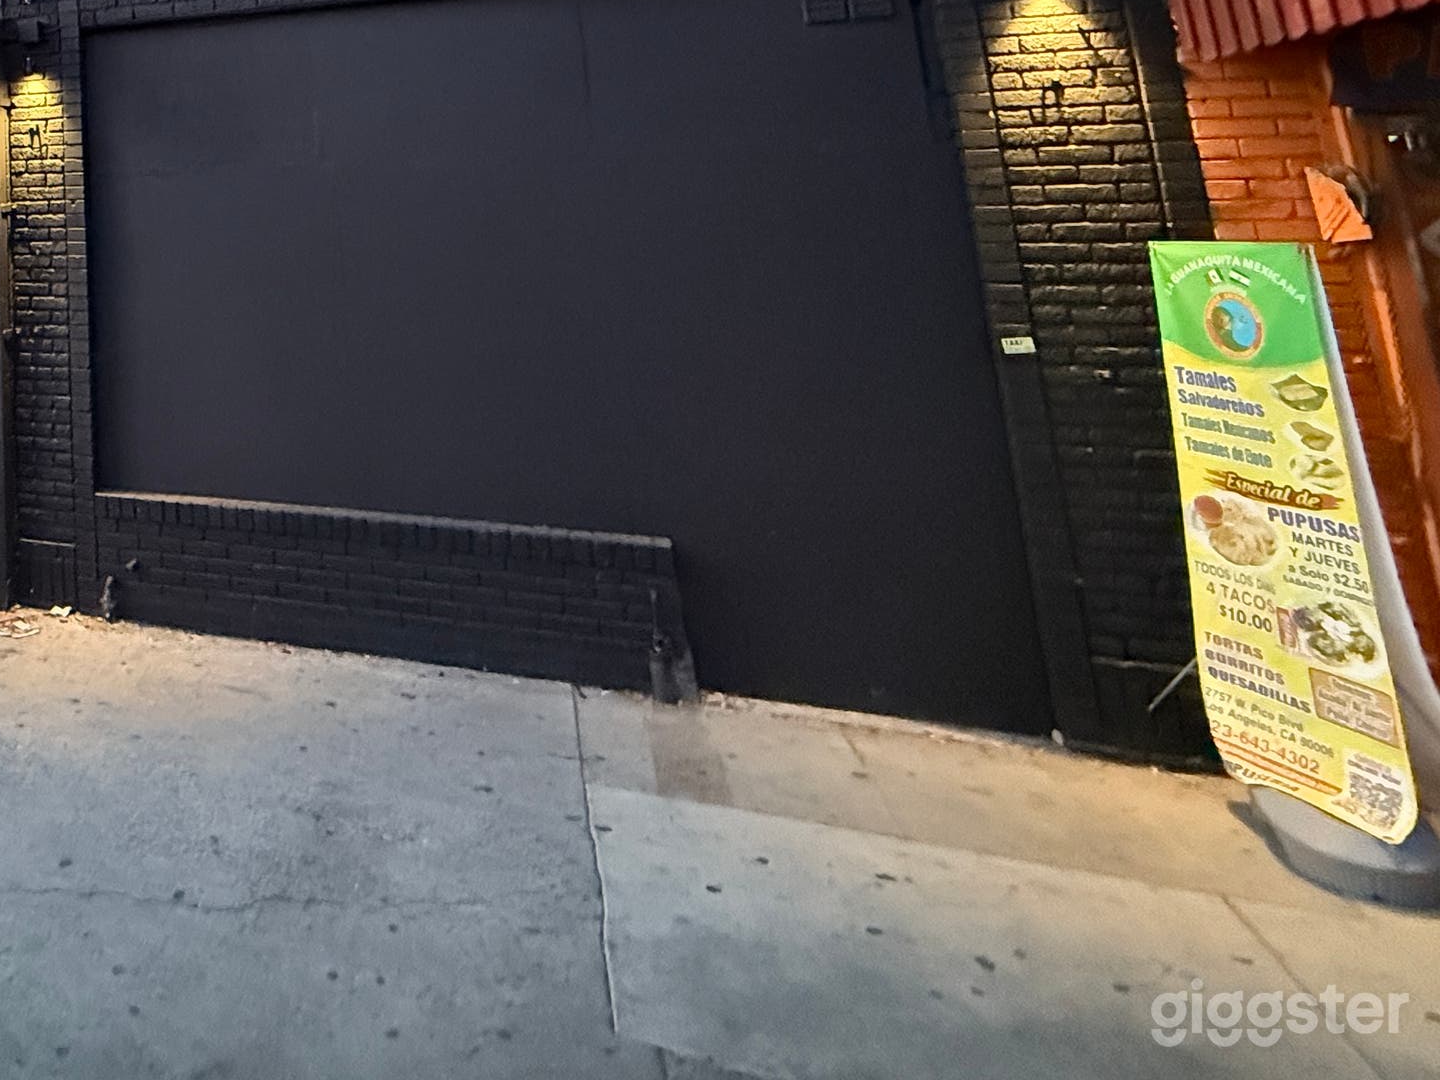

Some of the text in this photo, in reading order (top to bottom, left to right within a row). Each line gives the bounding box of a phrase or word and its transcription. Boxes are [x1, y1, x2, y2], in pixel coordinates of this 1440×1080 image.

[1242, 258, 1307, 305] MEXICANA
[1173, 366, 1237, 393] Tamales
[1224, 472, 1321, 508] Especial de
[1267, 506, 1361, 543] PUPUSAS
[1291, 531, 1354, 557] MARTES
[1193, 559, 1231, 581] TODOS
[1233, 572, 1254, 588] LOS
[1288, 545, 1361, 576] Y JUEVES
[1298, 565, 1330, 582] Solo
[1206, 580, 1276, 614] 4 TACOS
[1219, 604, 1273, 633] $10.00
[1204, 631, 1264, 660] TORTAS
[1204, 648, 1286, 685] BURRITOS
[1204, 686, 1233, 704] 2757
[1207, 666, 1312, 714] QUESADILLAS
[1279, 728, 1297, 744] CA
